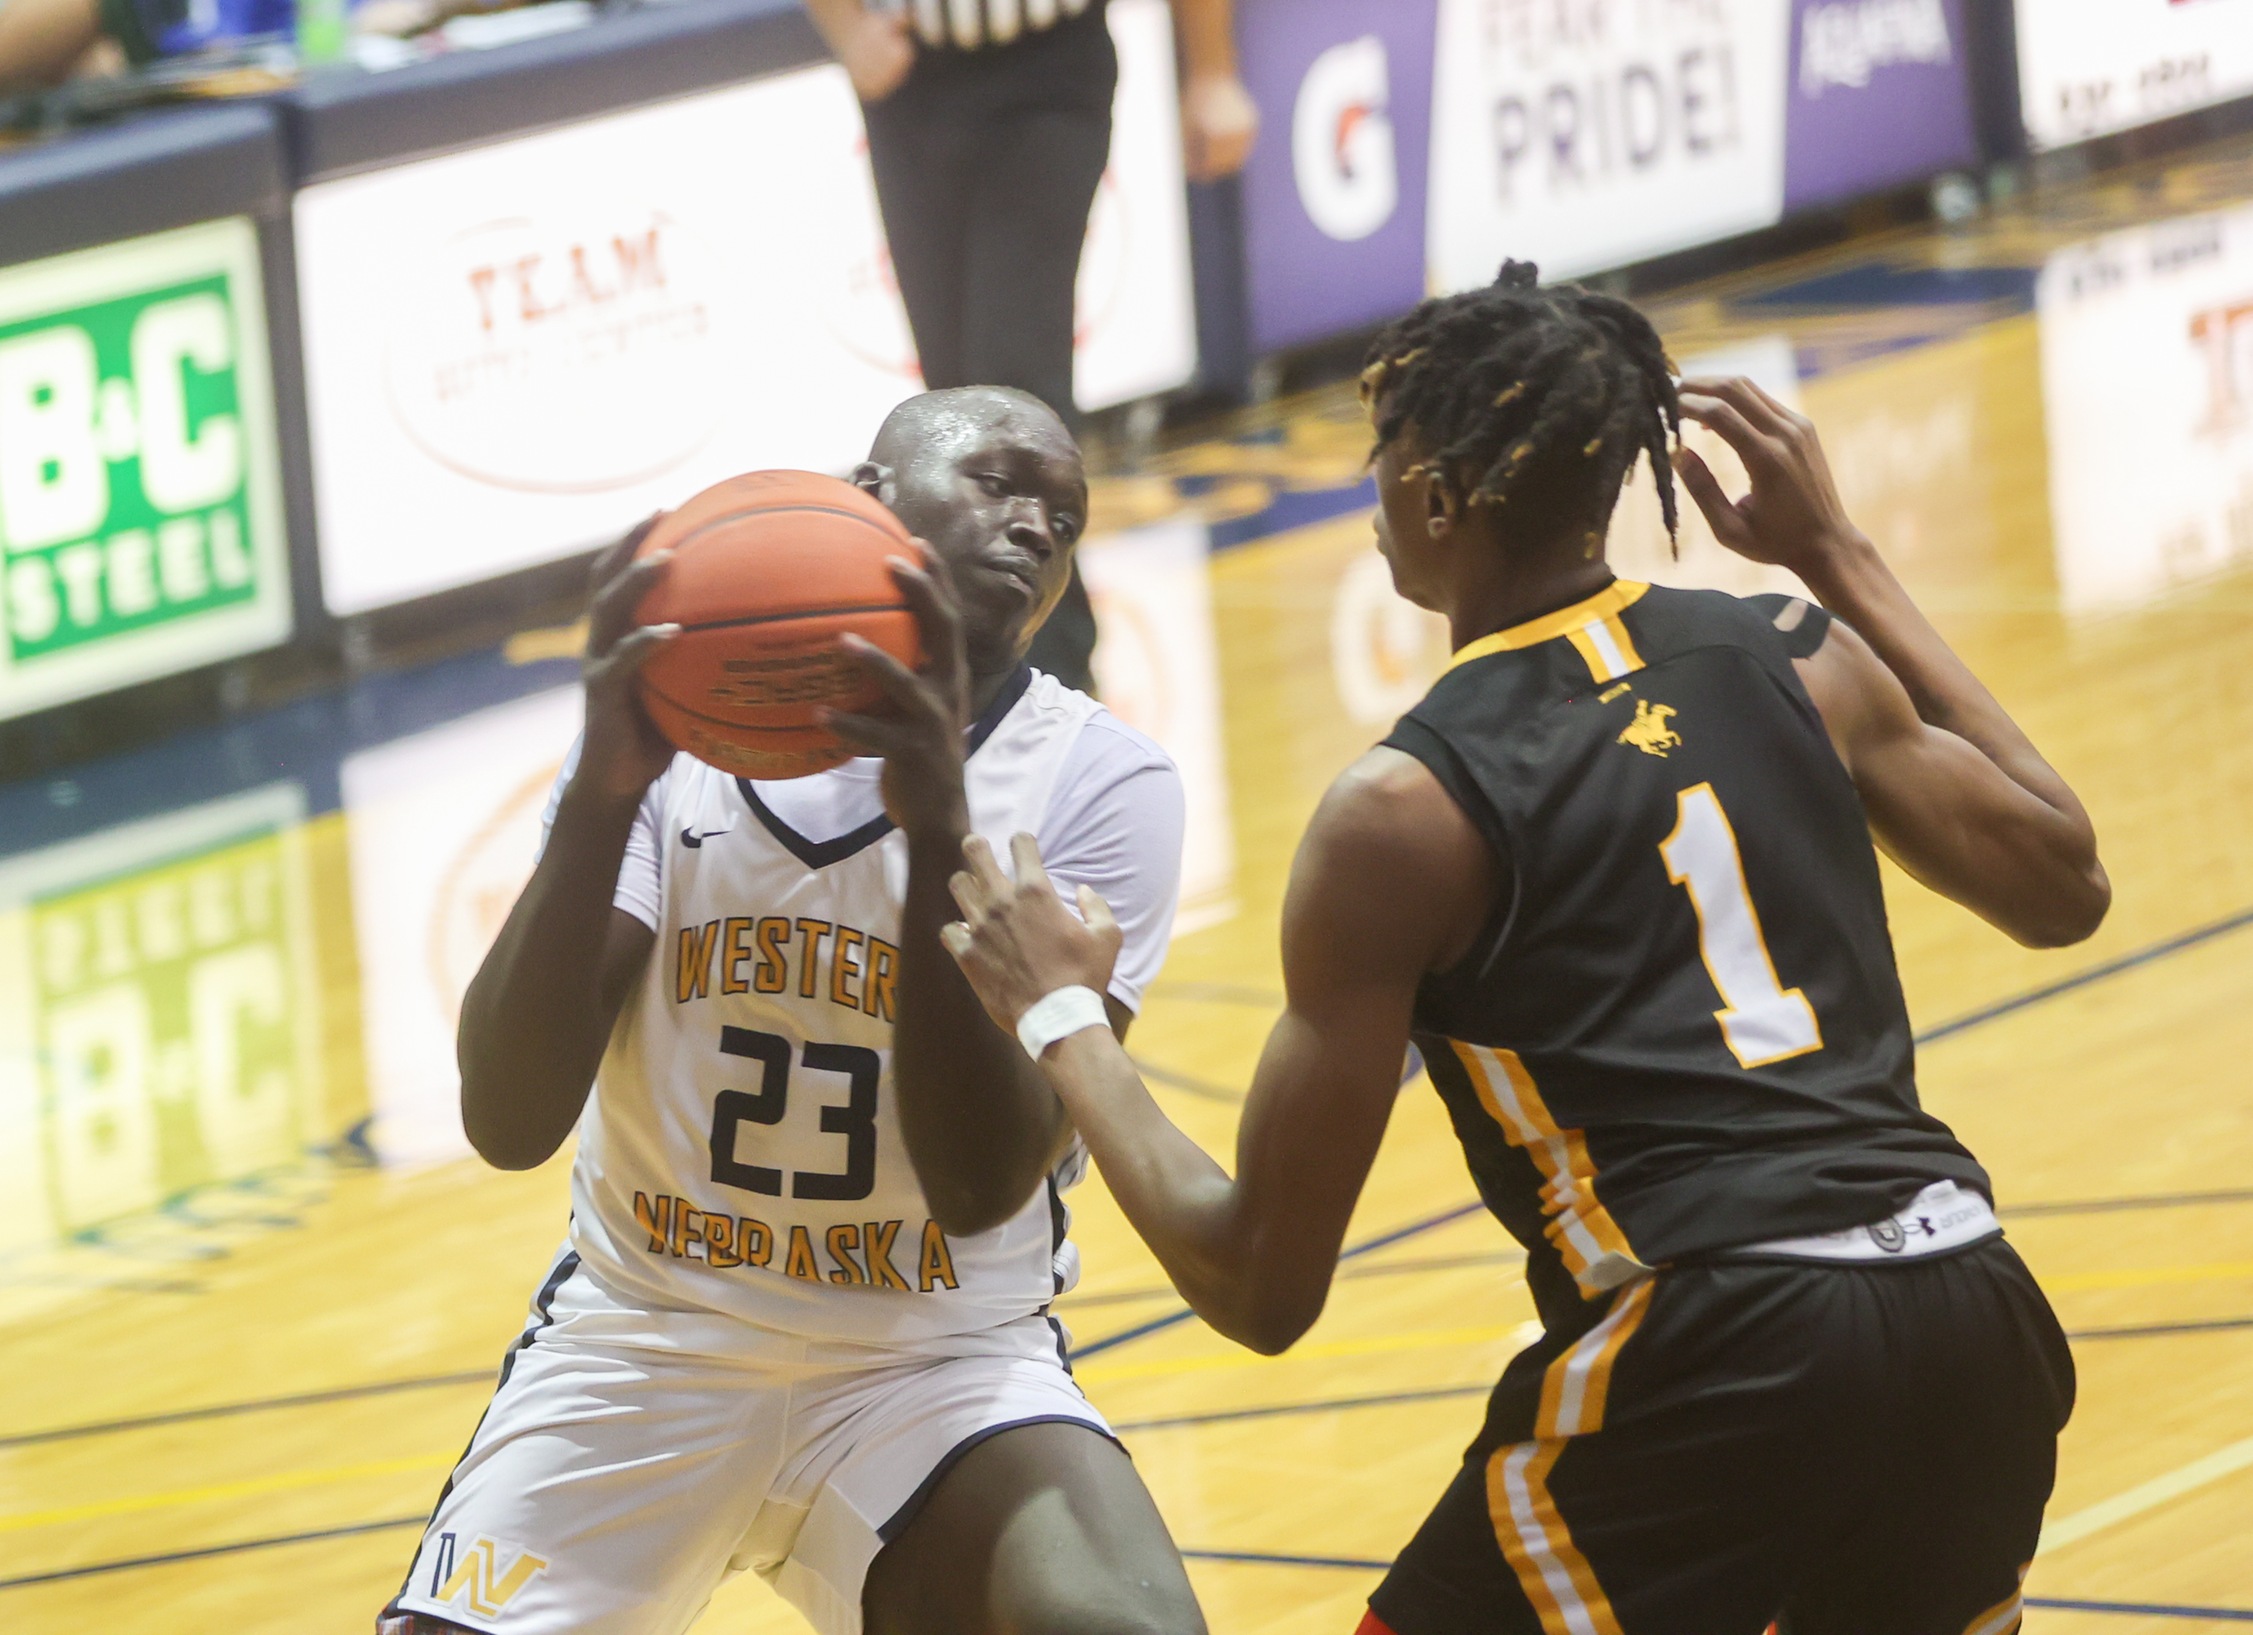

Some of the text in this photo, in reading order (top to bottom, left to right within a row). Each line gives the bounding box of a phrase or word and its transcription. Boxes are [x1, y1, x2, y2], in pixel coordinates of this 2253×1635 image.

[1291, 35, 1399, 242] G
[6, 507, 251, 643] STEEL
[676, 916, 901, 1024] WESTER
[1658, 781, 1824, 1070] 1
[710, 1025, 881, 1201] 23
[633, 1190, 960, 1293] NEBRASKA
